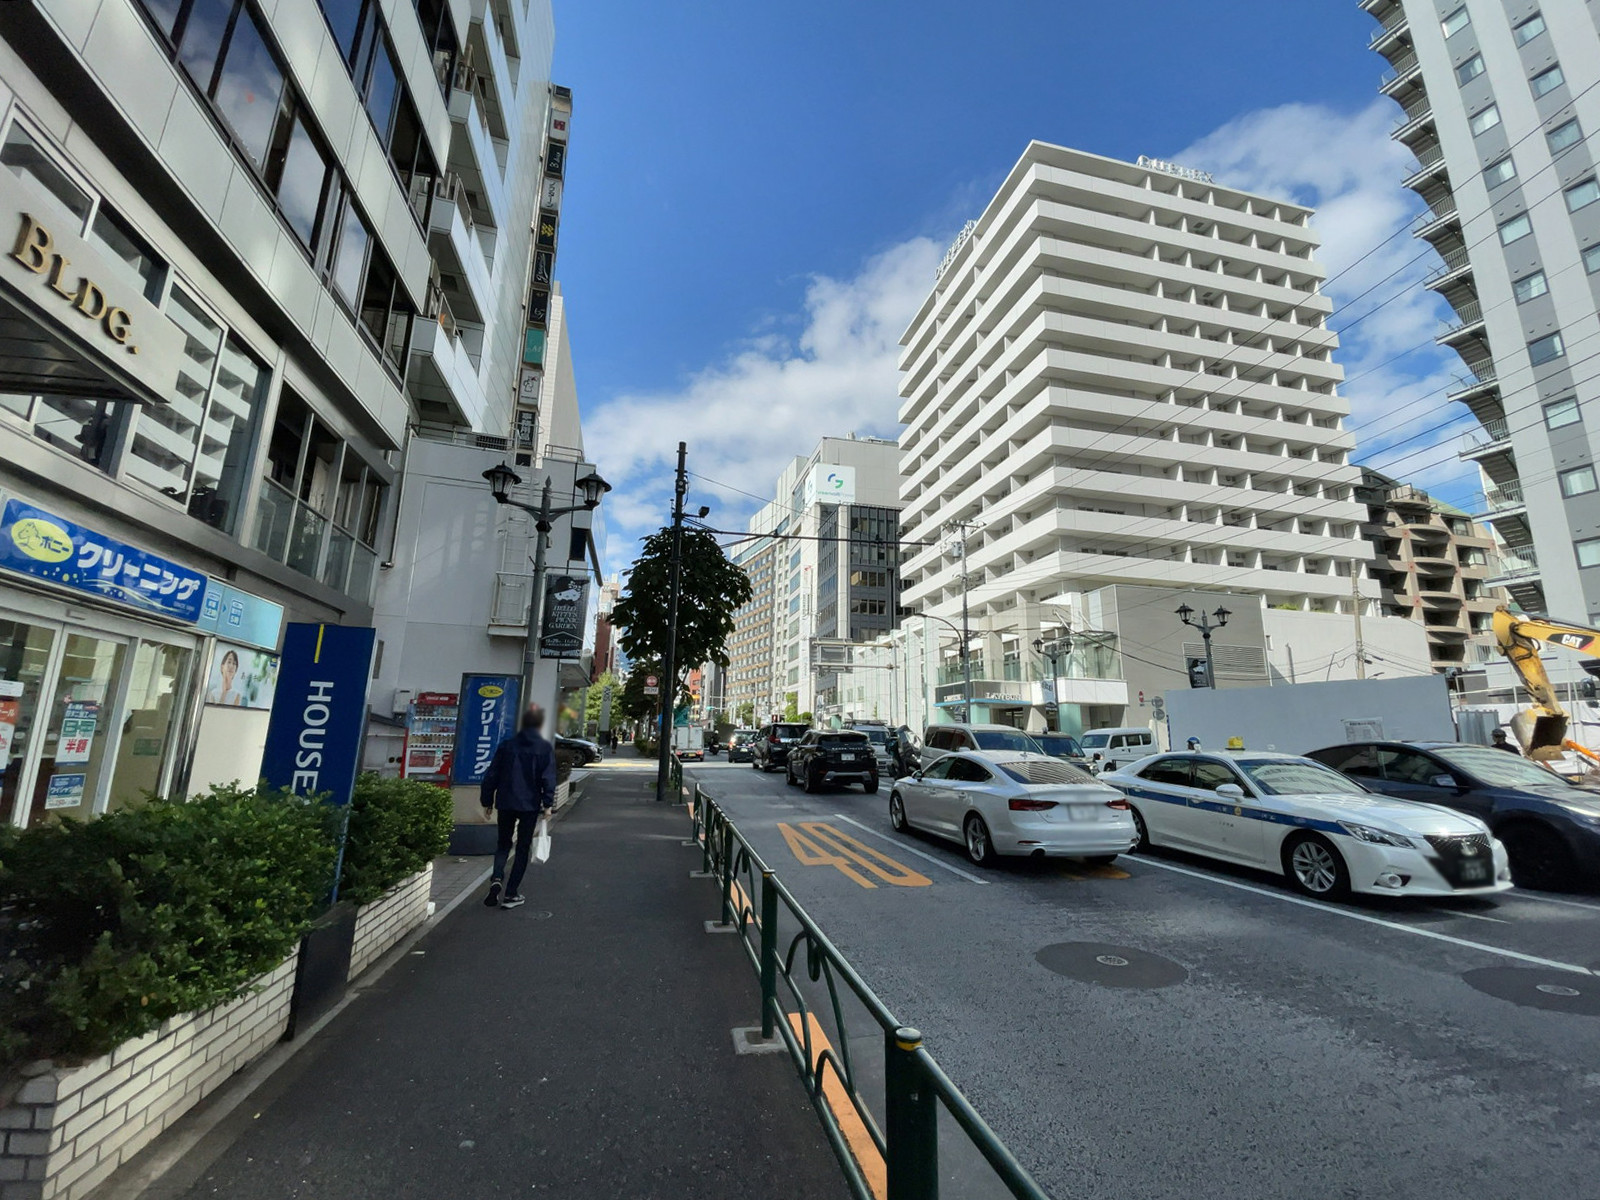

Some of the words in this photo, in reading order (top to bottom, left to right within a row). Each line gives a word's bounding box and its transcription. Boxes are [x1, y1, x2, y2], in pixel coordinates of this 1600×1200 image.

[8, 212, 139, 355] BLDG.
[77, 541, 200, 600] クリーニング
[1561, 634, 1583, 648] CAT
[65, 738, 88, 753] 半額
[292, 681, 334, 795] HOUSE
[474, 699, 496, 774] クリーニング
[776, 822, 933, 889] 40
